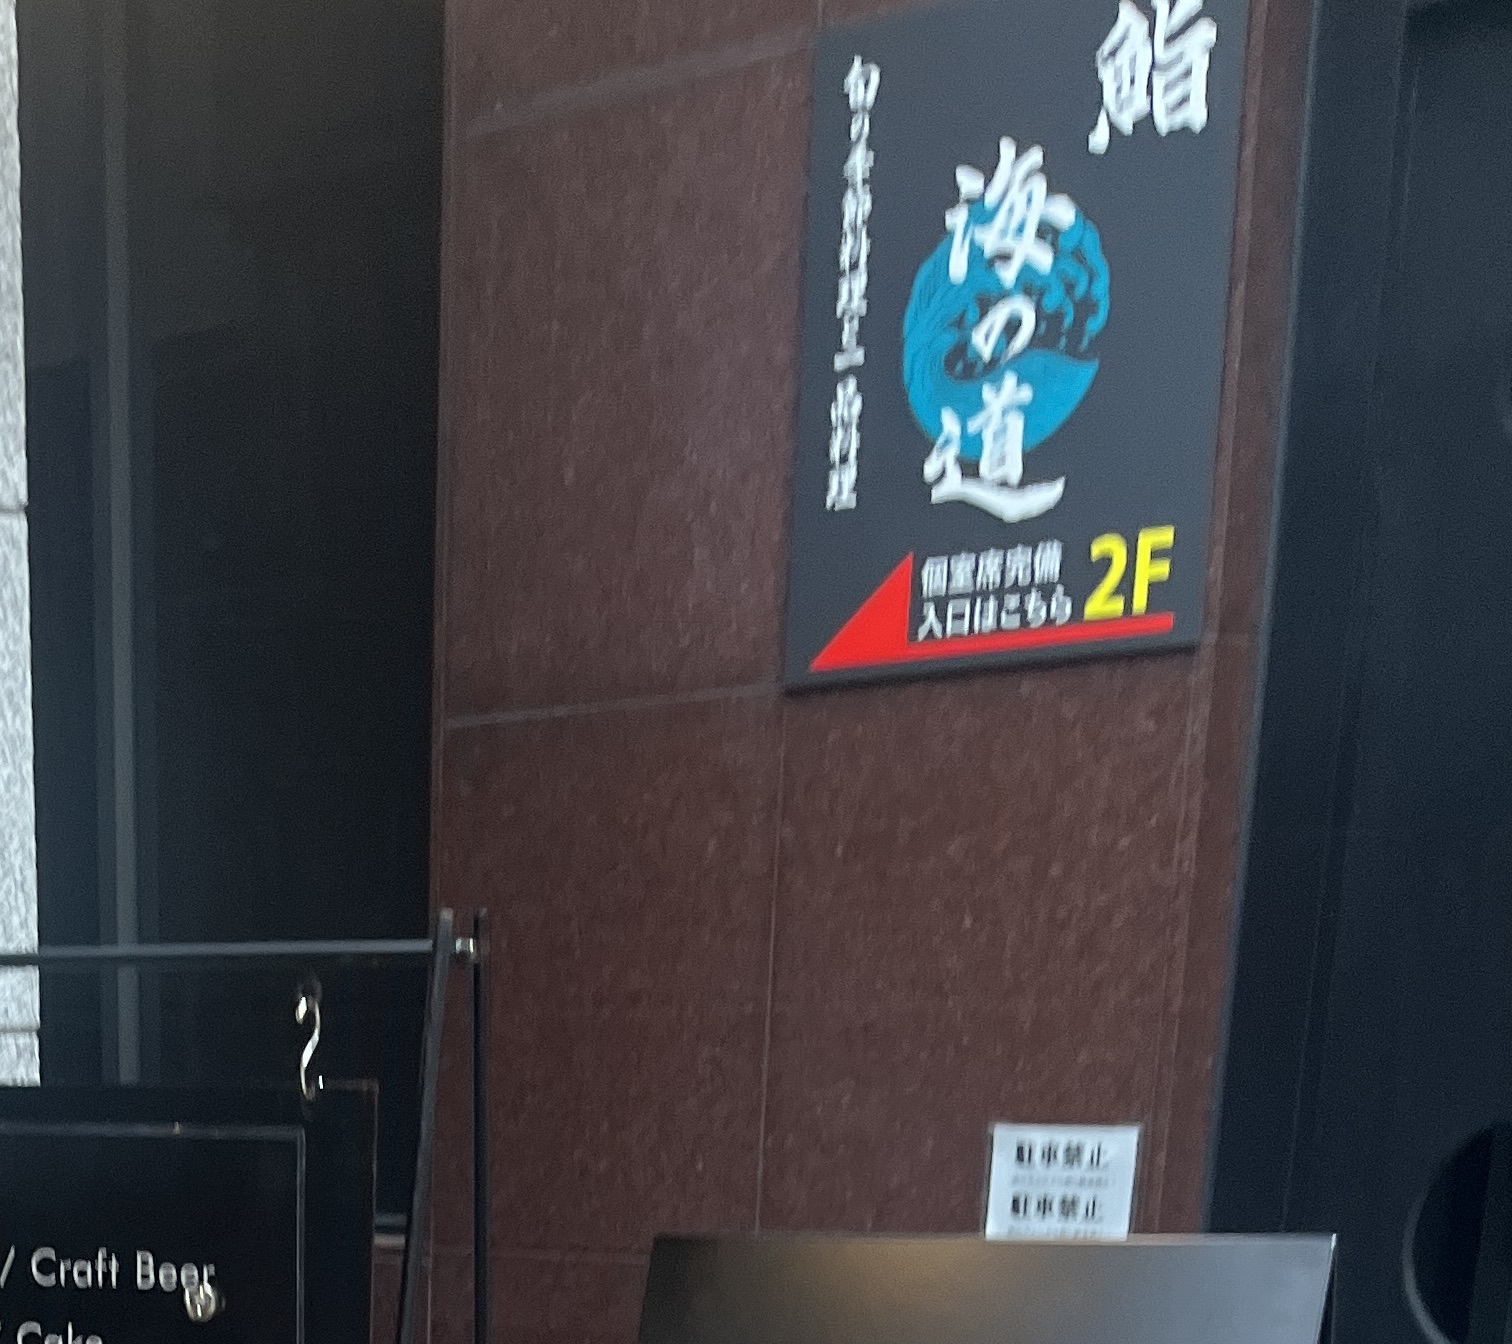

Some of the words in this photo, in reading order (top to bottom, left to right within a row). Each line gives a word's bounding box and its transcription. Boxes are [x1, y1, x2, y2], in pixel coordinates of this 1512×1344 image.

[1088, 0, 1219, 154] 鮨
[922, 136, 1076, 523] 海の道
[921, 538, 1063, 599] 個室席完備
[1083, 525, 1176, 622] 2F
[917, 583, 1073, 643] 入口はこちら
[1014, 1137, 1109, 1169] 駐車禁止
[1009, 1190, 1103, 1222] 駐車禁止
[30, 1246, 120, 1290] Craft
[135, 1249, 217, 1293] Beer
